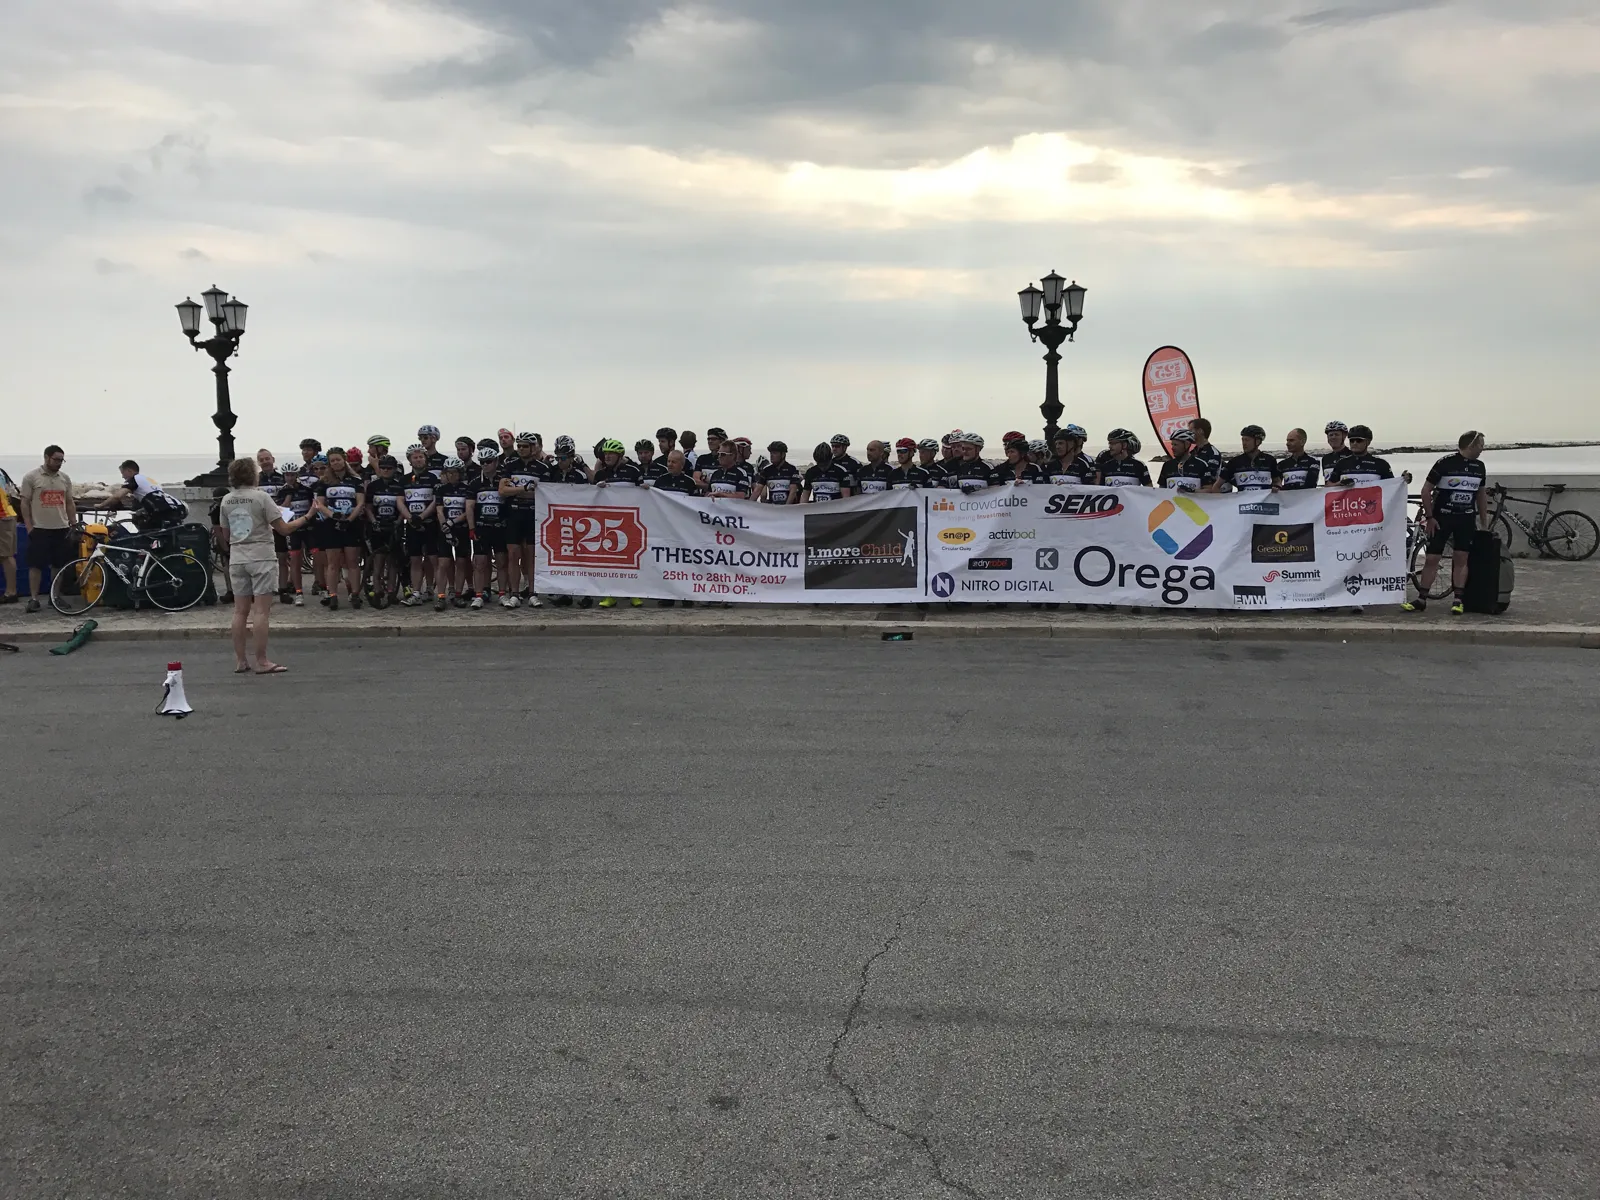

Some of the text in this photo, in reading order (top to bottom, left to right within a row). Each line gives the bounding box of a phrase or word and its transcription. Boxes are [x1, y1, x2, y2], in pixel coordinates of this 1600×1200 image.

[1290, 474, 1306, 482] Oreg
[1461, 480, 1479, 489] Oreg
[339, 489, 356, 497] Oreg
[487, 494, 502, 502] Oreg
[959, 494, 1028, 512] crowdcube
[1044, 494, 1120, 515] SEKO
[1332, 497, 1367, 512] Ella's
[976, 511, 1011, 520] Investment
[1333, 511, 1362, 519] kitchen
[560, 516, 629, 557] RIDE 25
[715, 531, 736, 546] to
[943, 531, 971, 541] sn@p
[988, 528, 1036, 541] activbod
[807, 543, 903, 558] 1moreChild
[1257, 544, 1308, 554] Gressingham
[1336, 544, 1392, 563] buyagift
[651, 546, 800, 568] THESSALONIKI
[550, 569, 575, 577] EXPLORE
[662, 570, 787, 586] 25th to 28th May 2017
[1074, 545, 1215, 605] Orega
[1281, 569, 1321, 580] Summit
[961, 580, 1055, 592] NITRO DIGITAL
[1363, 576, 1406, 586] THUNDER
[693, 583, 757, 595] IN AID OF...
[1234, 594, 1268, 605] EMW
